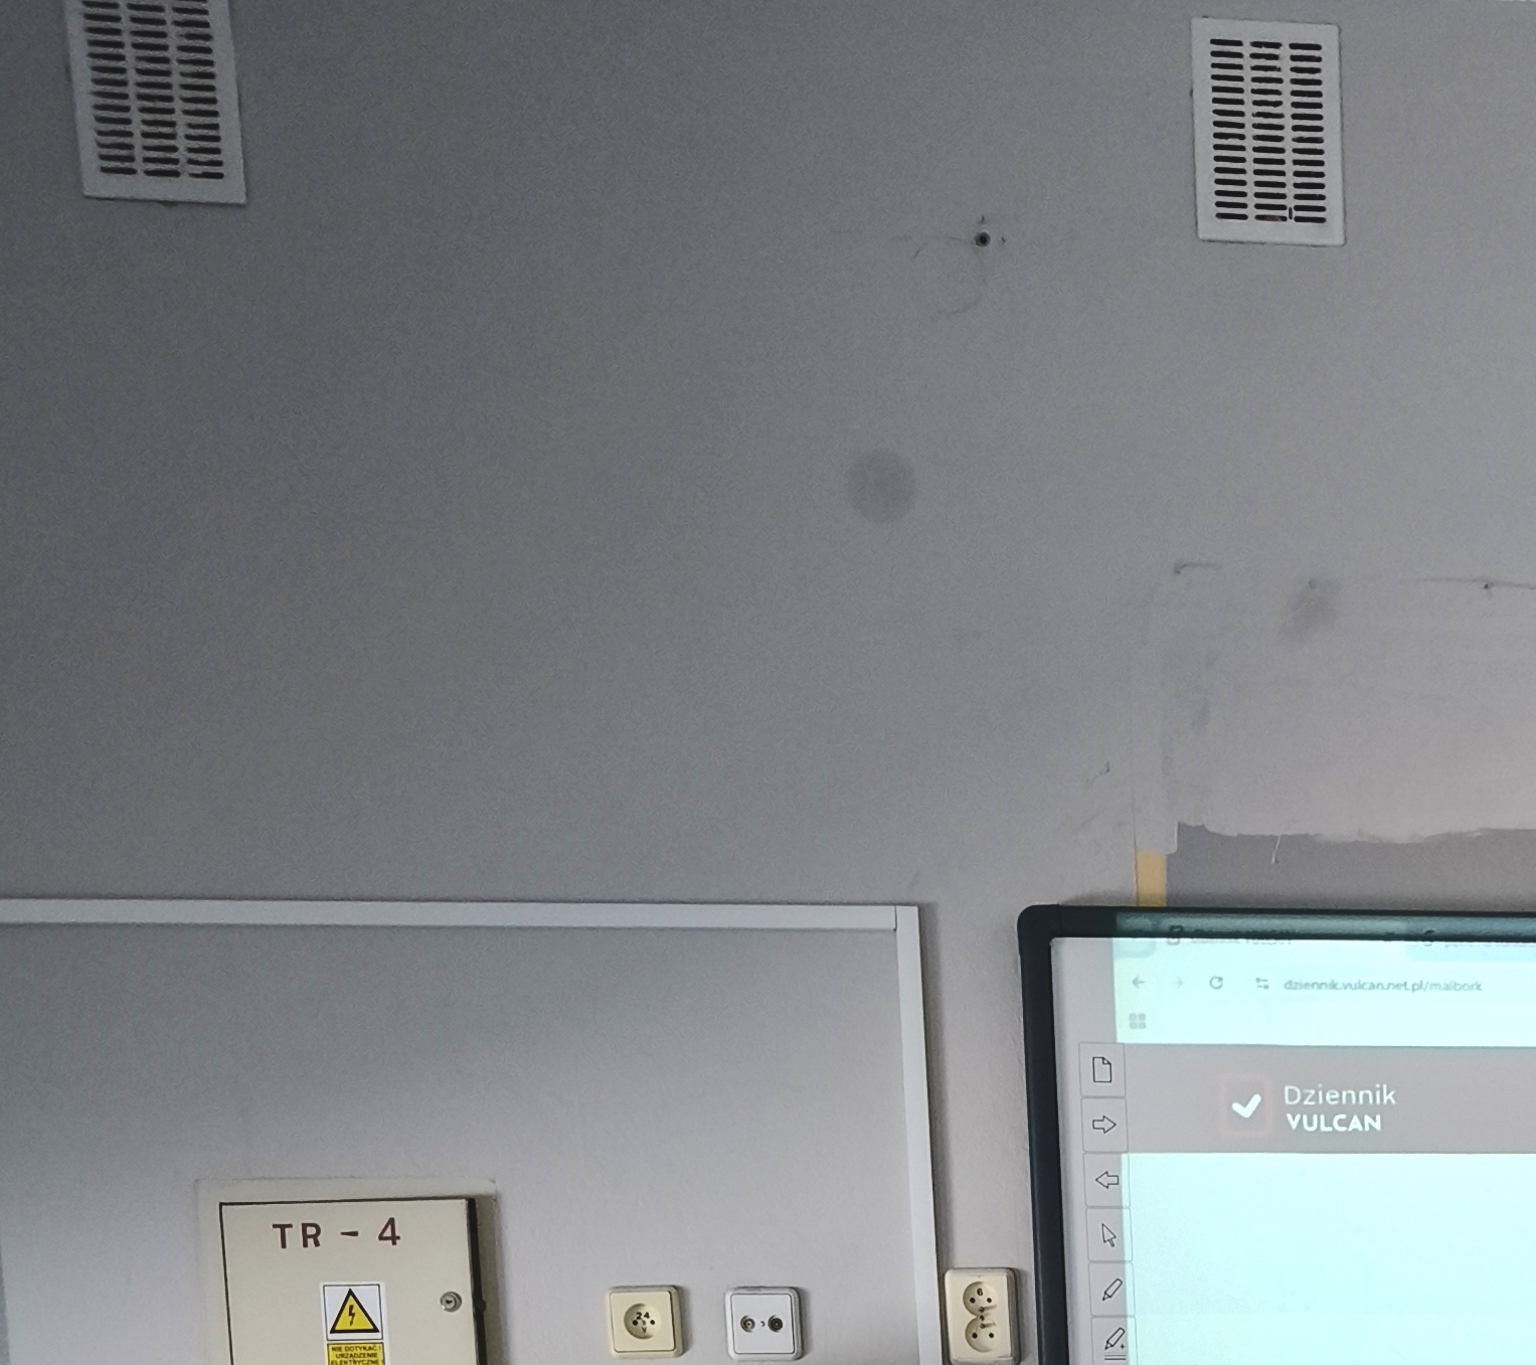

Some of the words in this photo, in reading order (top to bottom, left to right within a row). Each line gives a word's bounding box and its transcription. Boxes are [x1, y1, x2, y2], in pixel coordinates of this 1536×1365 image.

[1284, 1084, 1396, 1106] Dziennik
[1286, 1113, 1382, 1132] VULCAN
[271, 1222, 322, 1250] TR
[377, 1216, 401, 1246] 4
